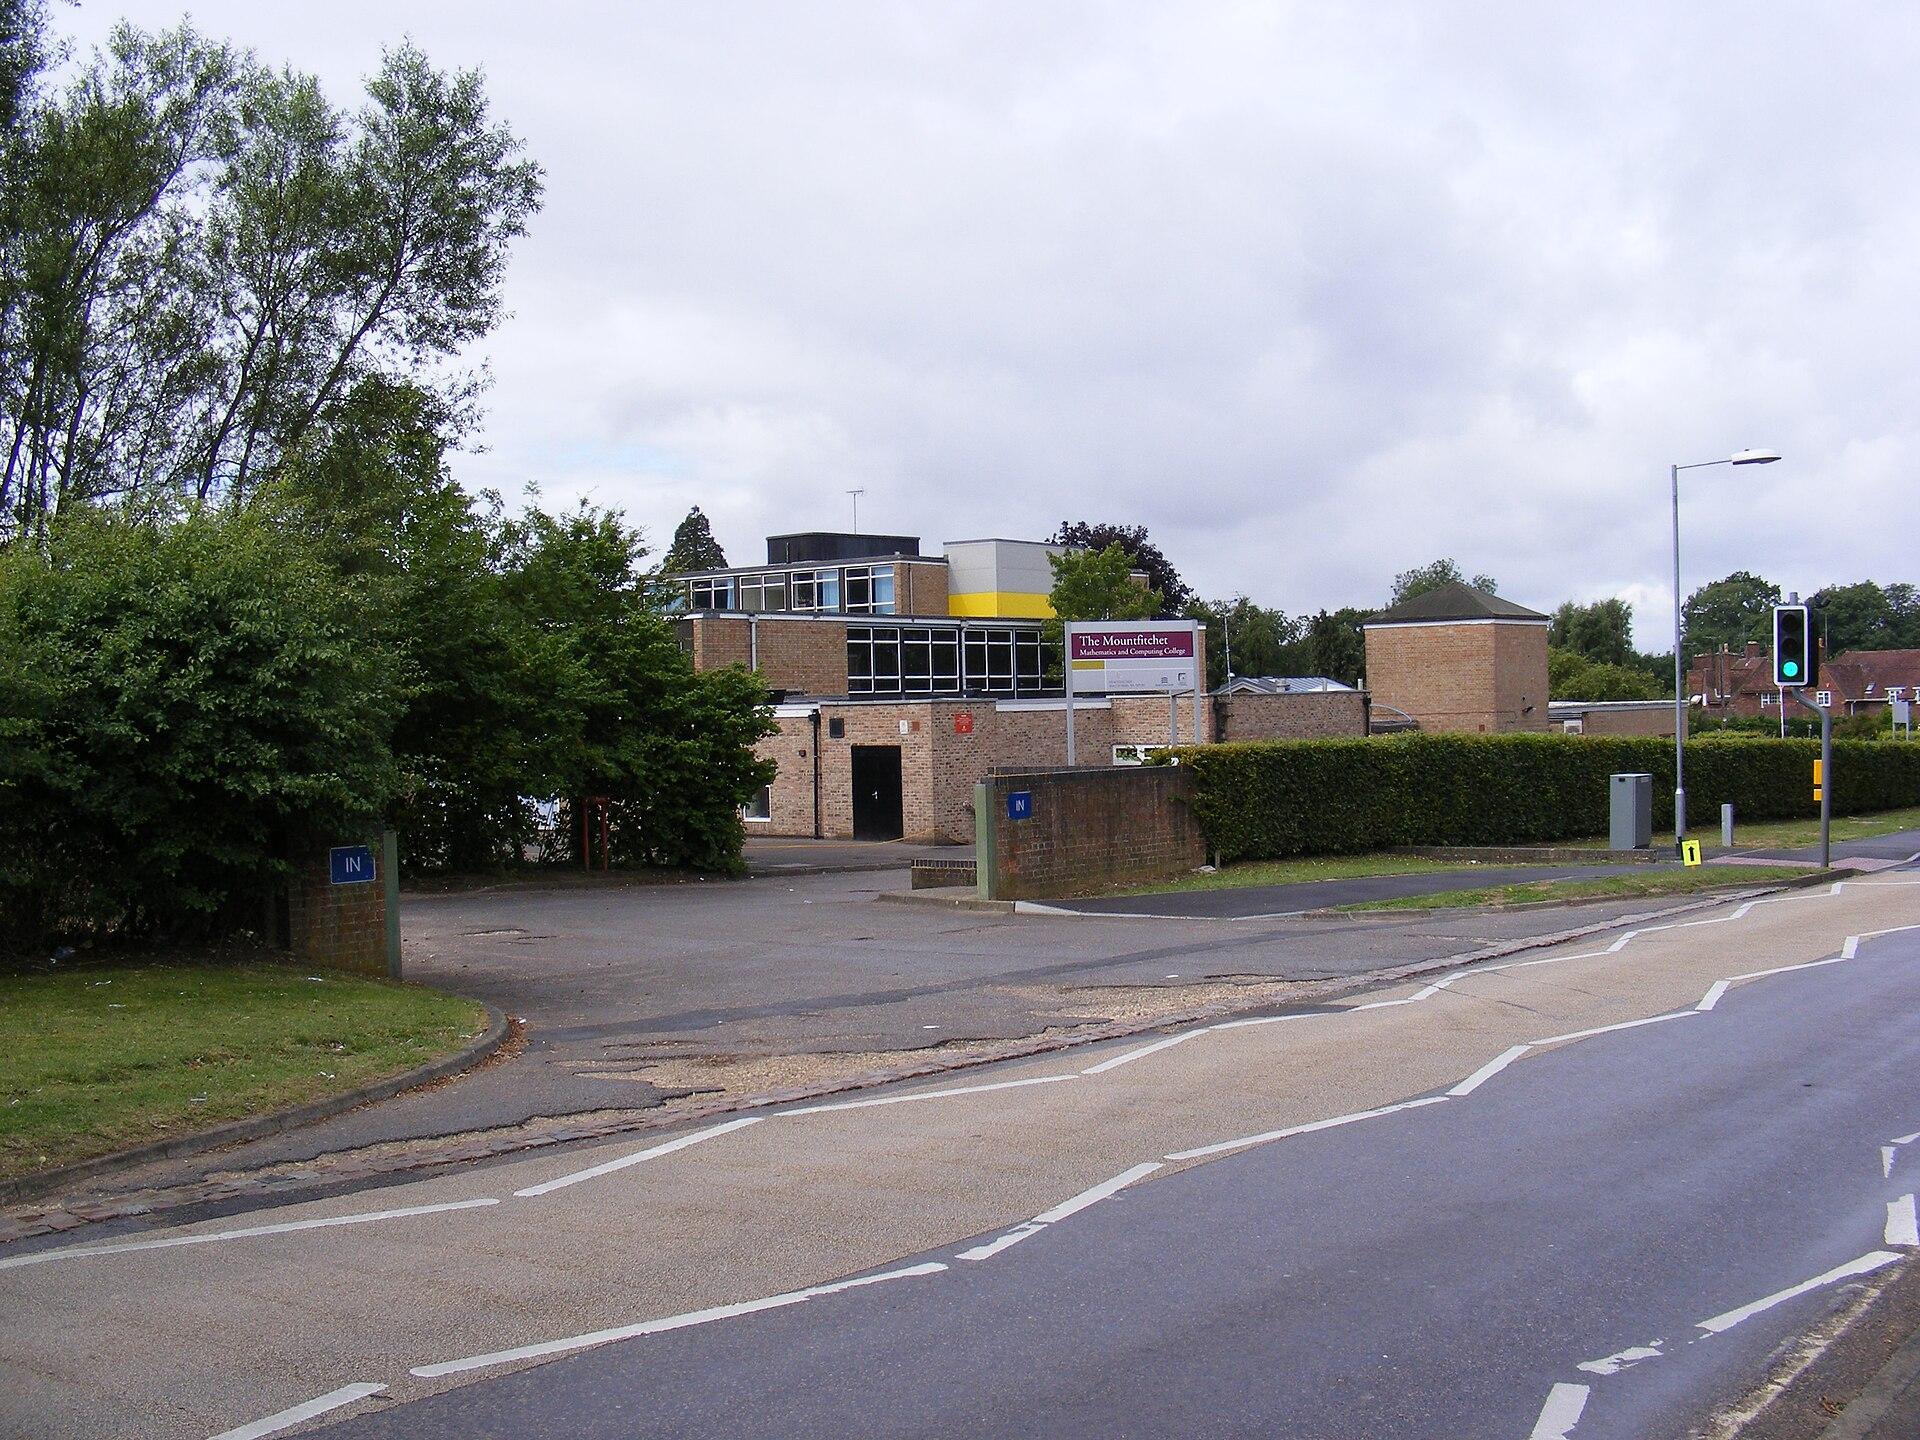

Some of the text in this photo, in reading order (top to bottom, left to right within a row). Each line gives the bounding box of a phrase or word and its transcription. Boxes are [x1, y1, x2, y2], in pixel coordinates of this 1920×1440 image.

[1079, 634, 1168, 646] The Mountfitchet
[1117, 648, 1129, 656] and
[1130, 648, 1164, 657] Computing
[1164, 647, 1186, 656] College
[1015, 799, 1025, 811] IN
[345, 856, 361, 873] IN
